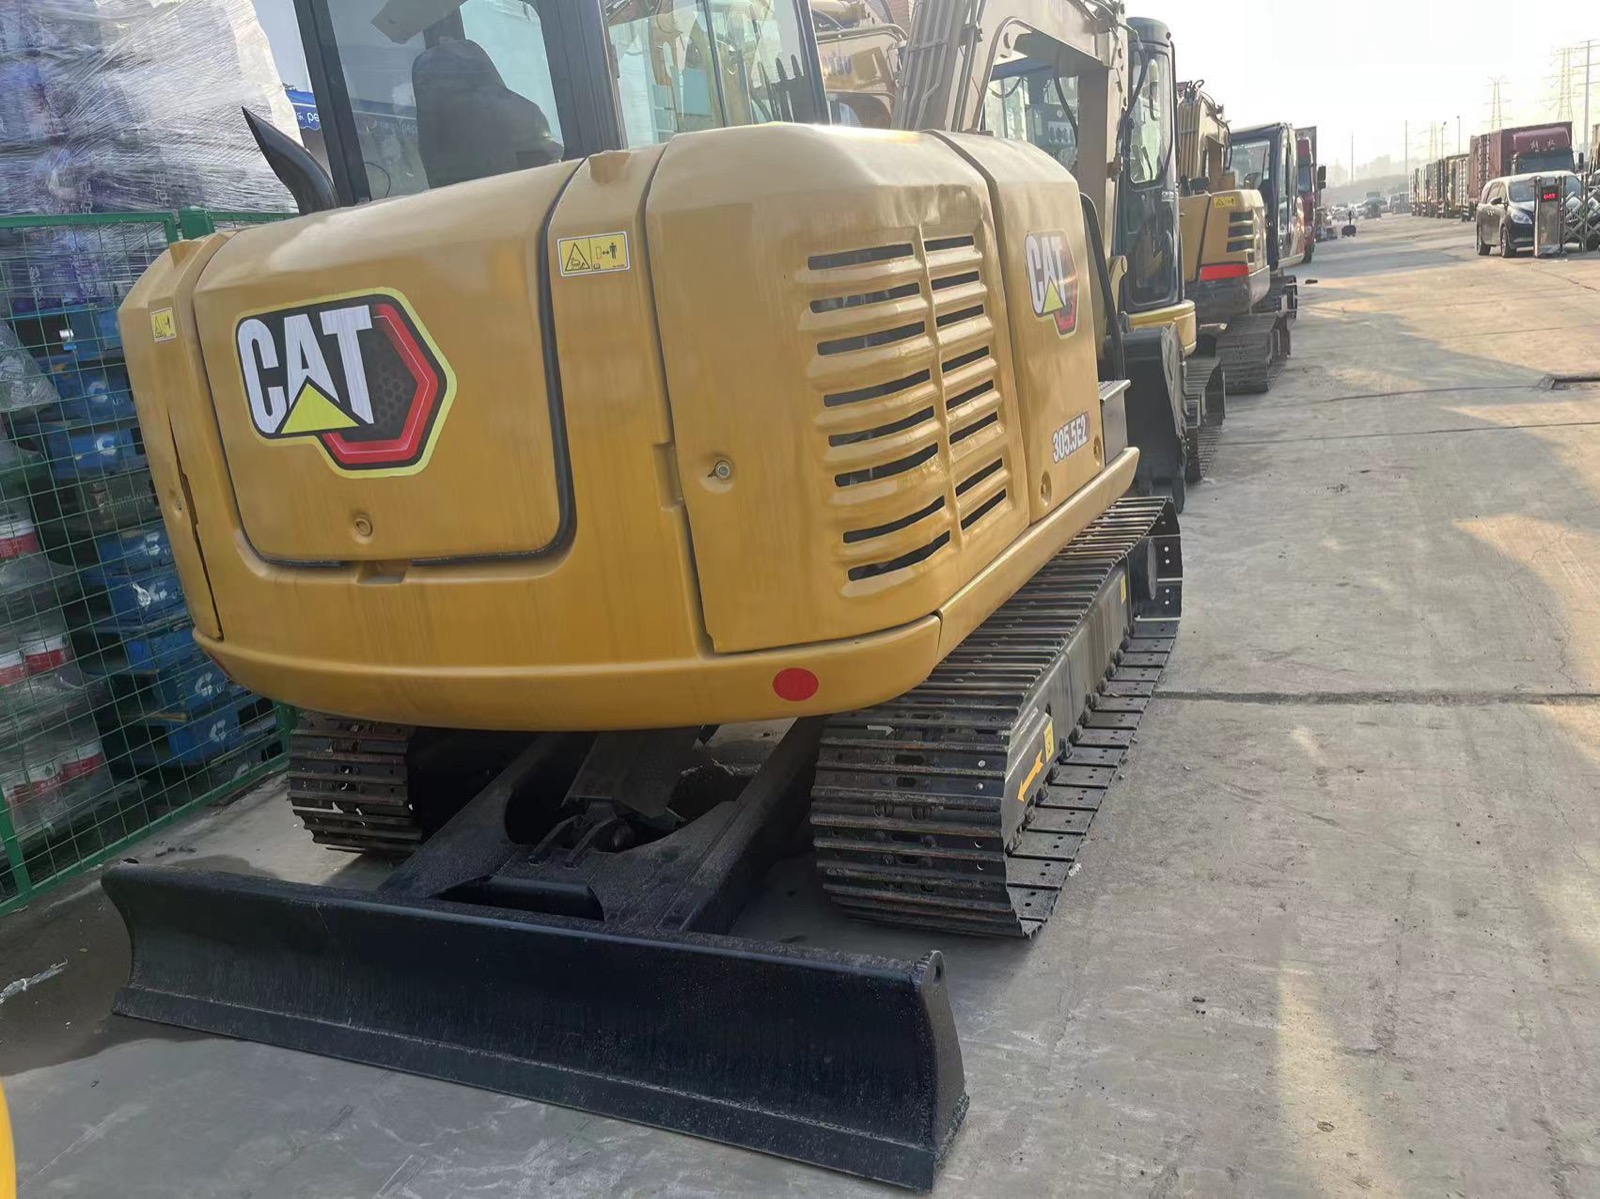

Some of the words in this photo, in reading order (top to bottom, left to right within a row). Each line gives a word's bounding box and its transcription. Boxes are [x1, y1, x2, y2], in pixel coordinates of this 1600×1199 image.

[1026, 234, 1066, 314] CAT
[238, 305, 375, 434] CAT
[1053, 414, 1088, 462] 305.5E2
